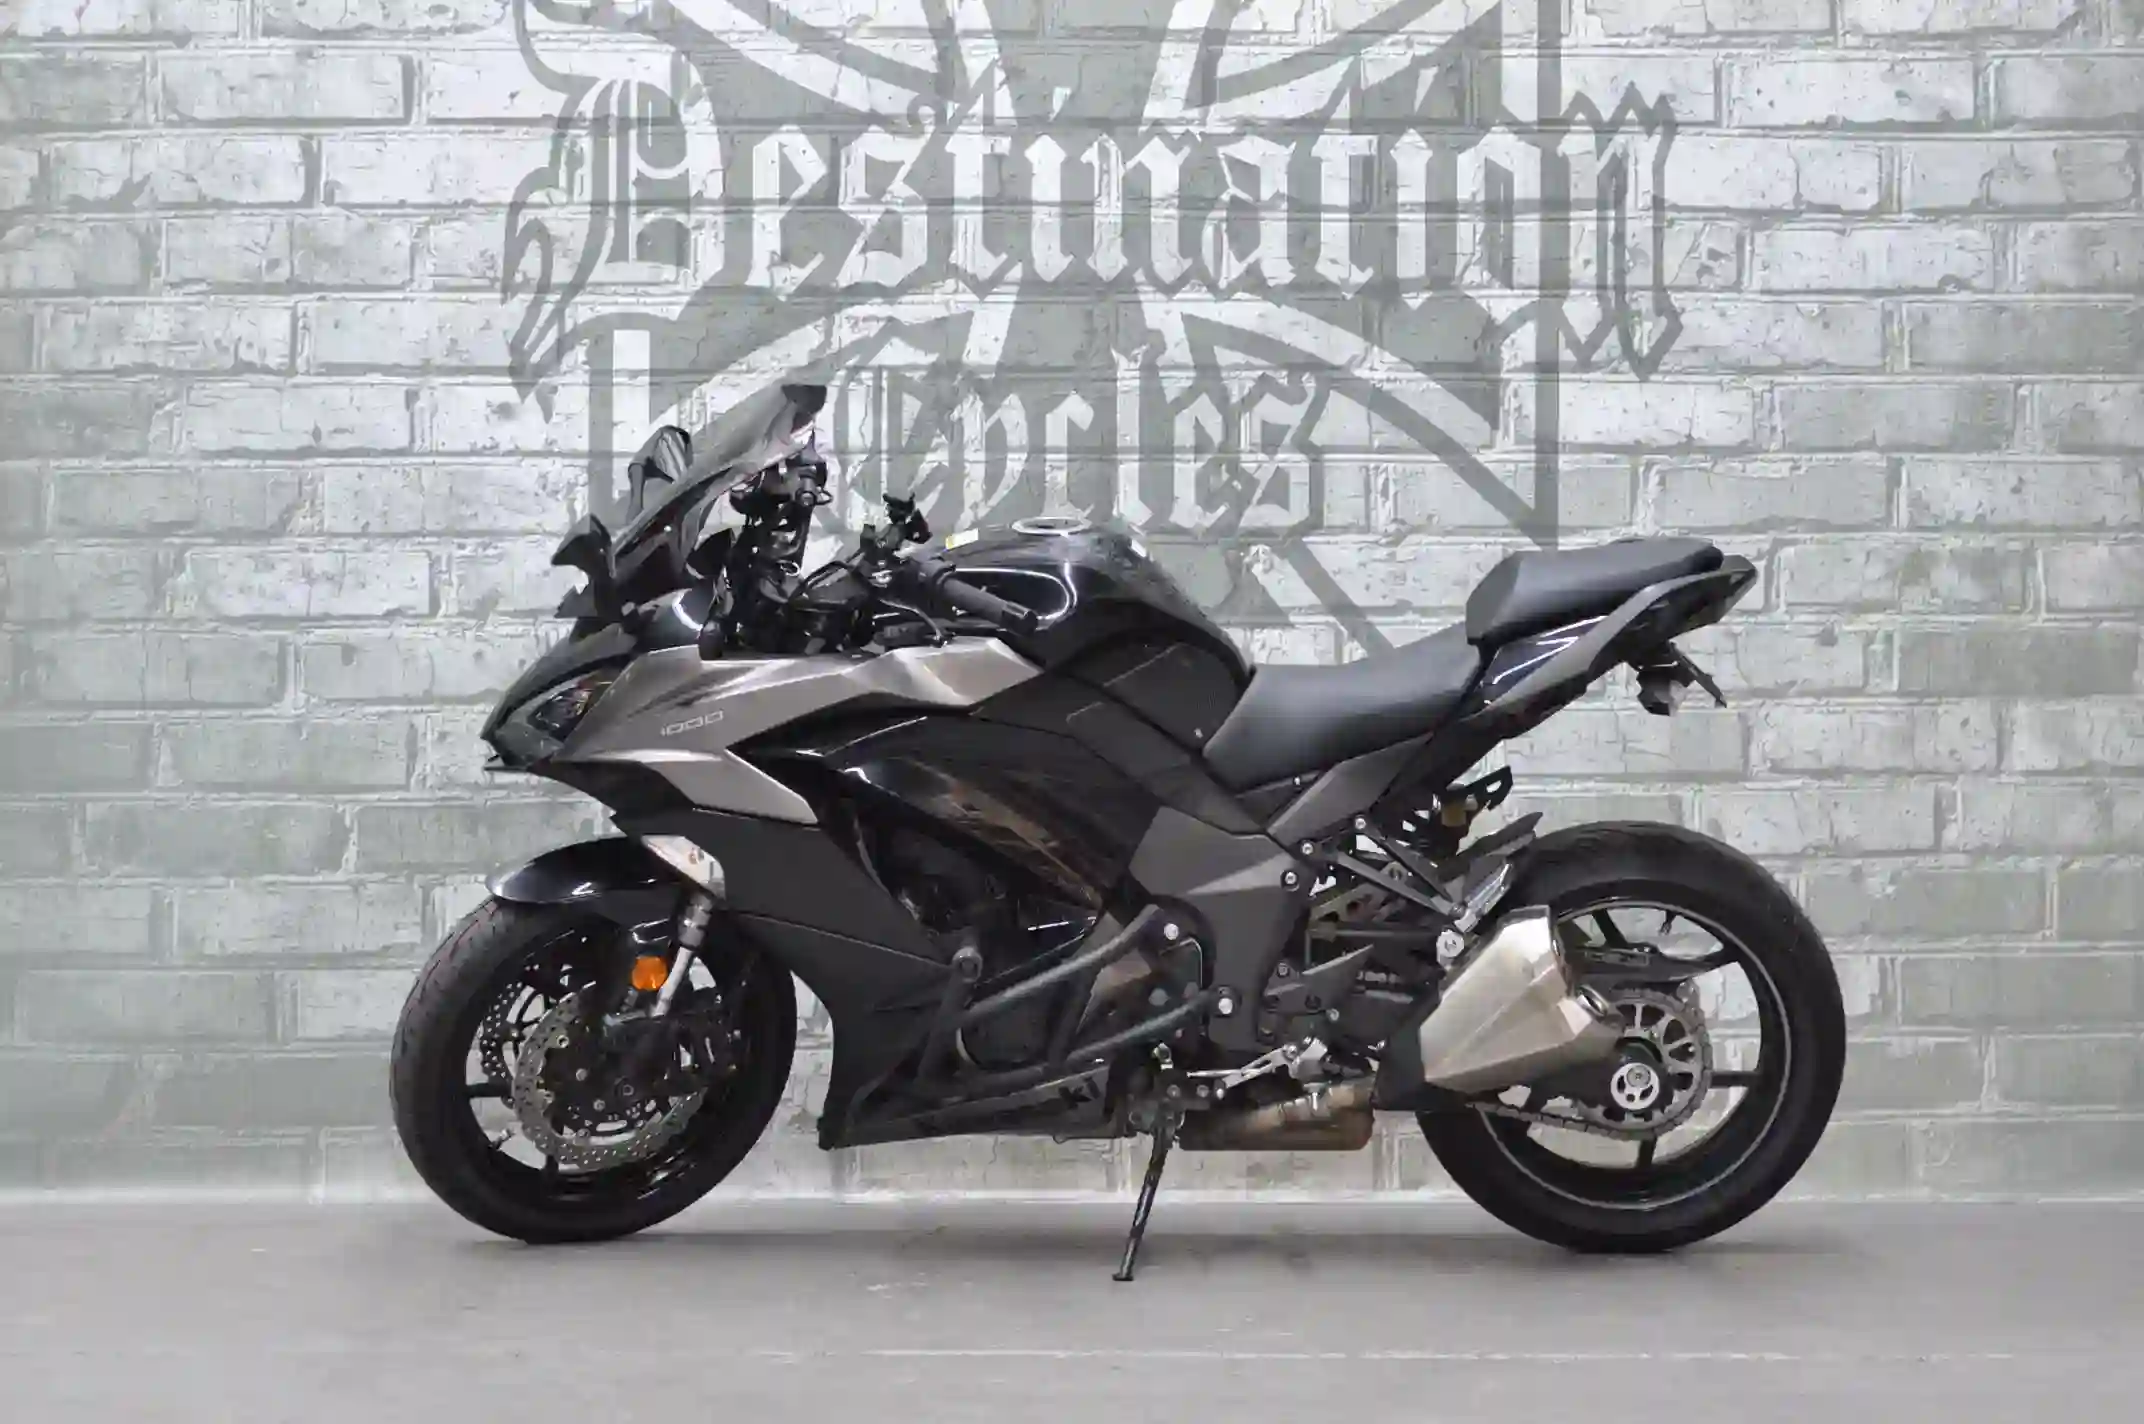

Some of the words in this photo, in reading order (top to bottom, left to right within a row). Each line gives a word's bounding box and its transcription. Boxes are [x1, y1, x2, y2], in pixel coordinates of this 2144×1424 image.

[504, 8, 1682, 383] Destination
[834, 338, 1322, 538] Cycles
[660, 710, 724, 736] 1000
